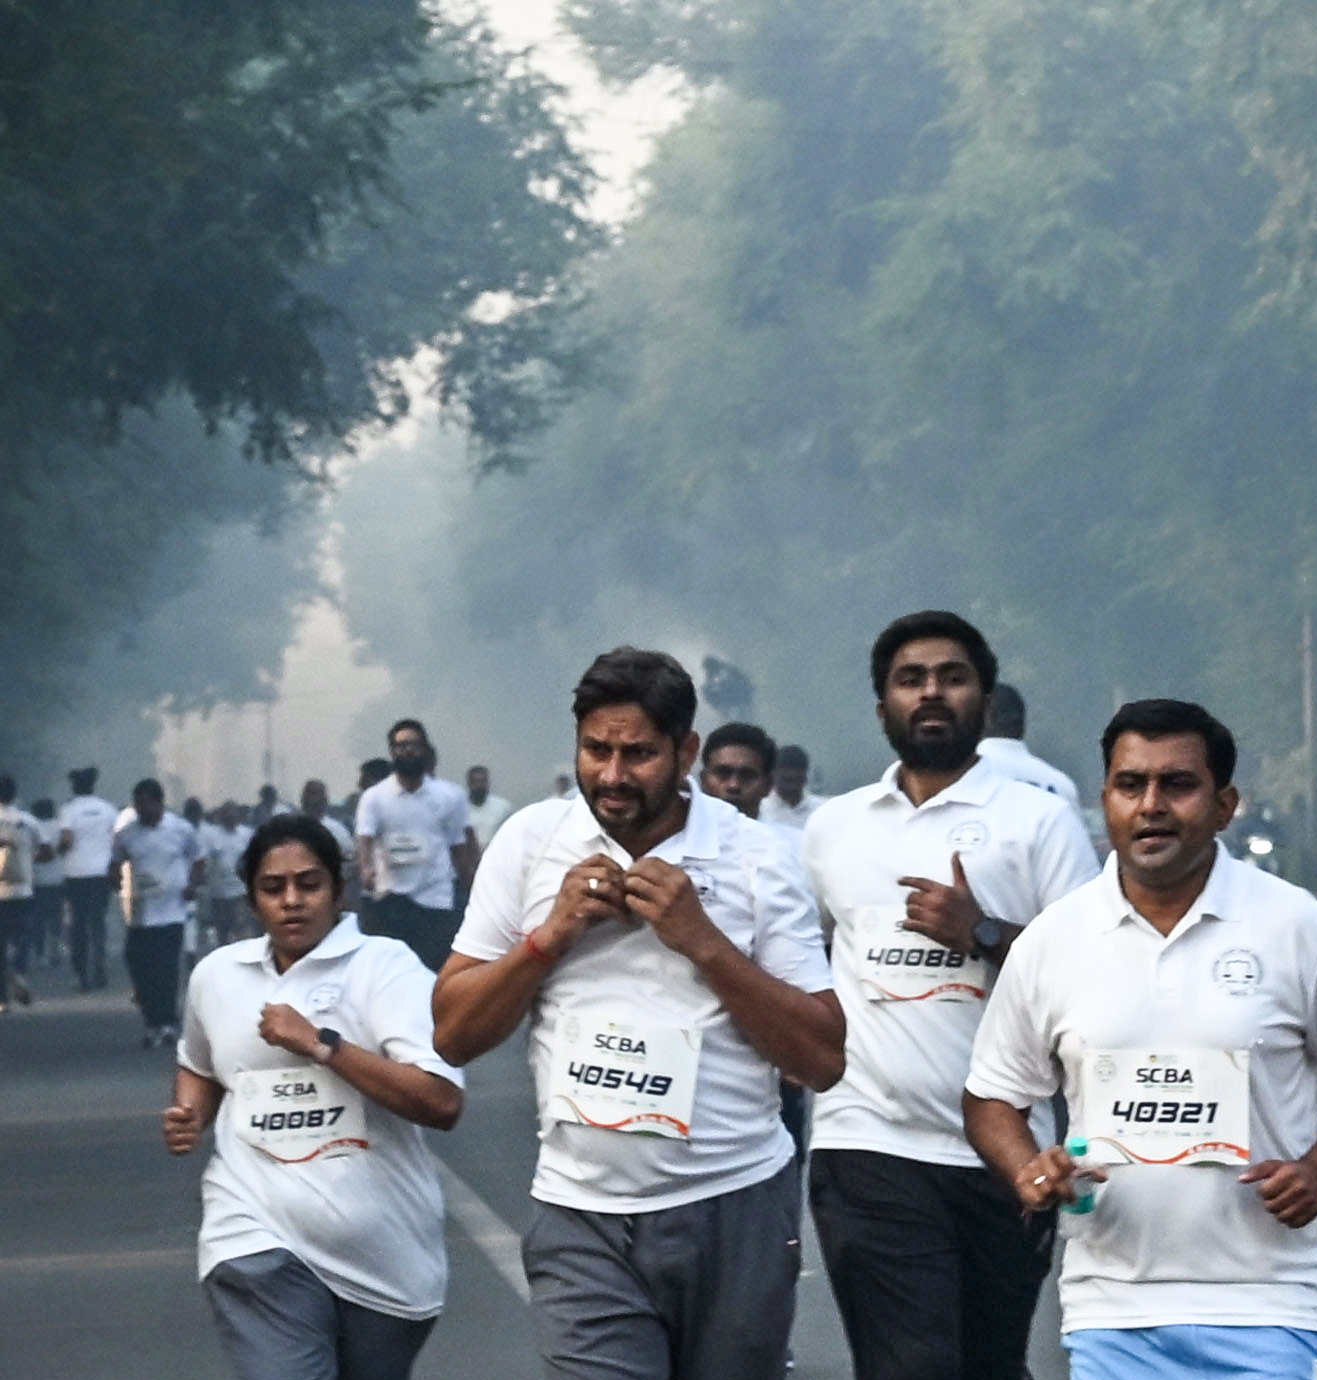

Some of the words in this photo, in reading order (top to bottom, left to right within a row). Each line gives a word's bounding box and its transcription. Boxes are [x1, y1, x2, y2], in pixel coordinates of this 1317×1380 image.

[594, 1033, 646, 1055] SCBA
[568, 1061, 673, 1096] 40549
[1136, 1068, 1193, 1083] SCBA
[272, 1082, 317, 1098] SCBA
[251, 1106, 345, 1131] 40087
[1112, 1100, 1218, 1123] 40321
